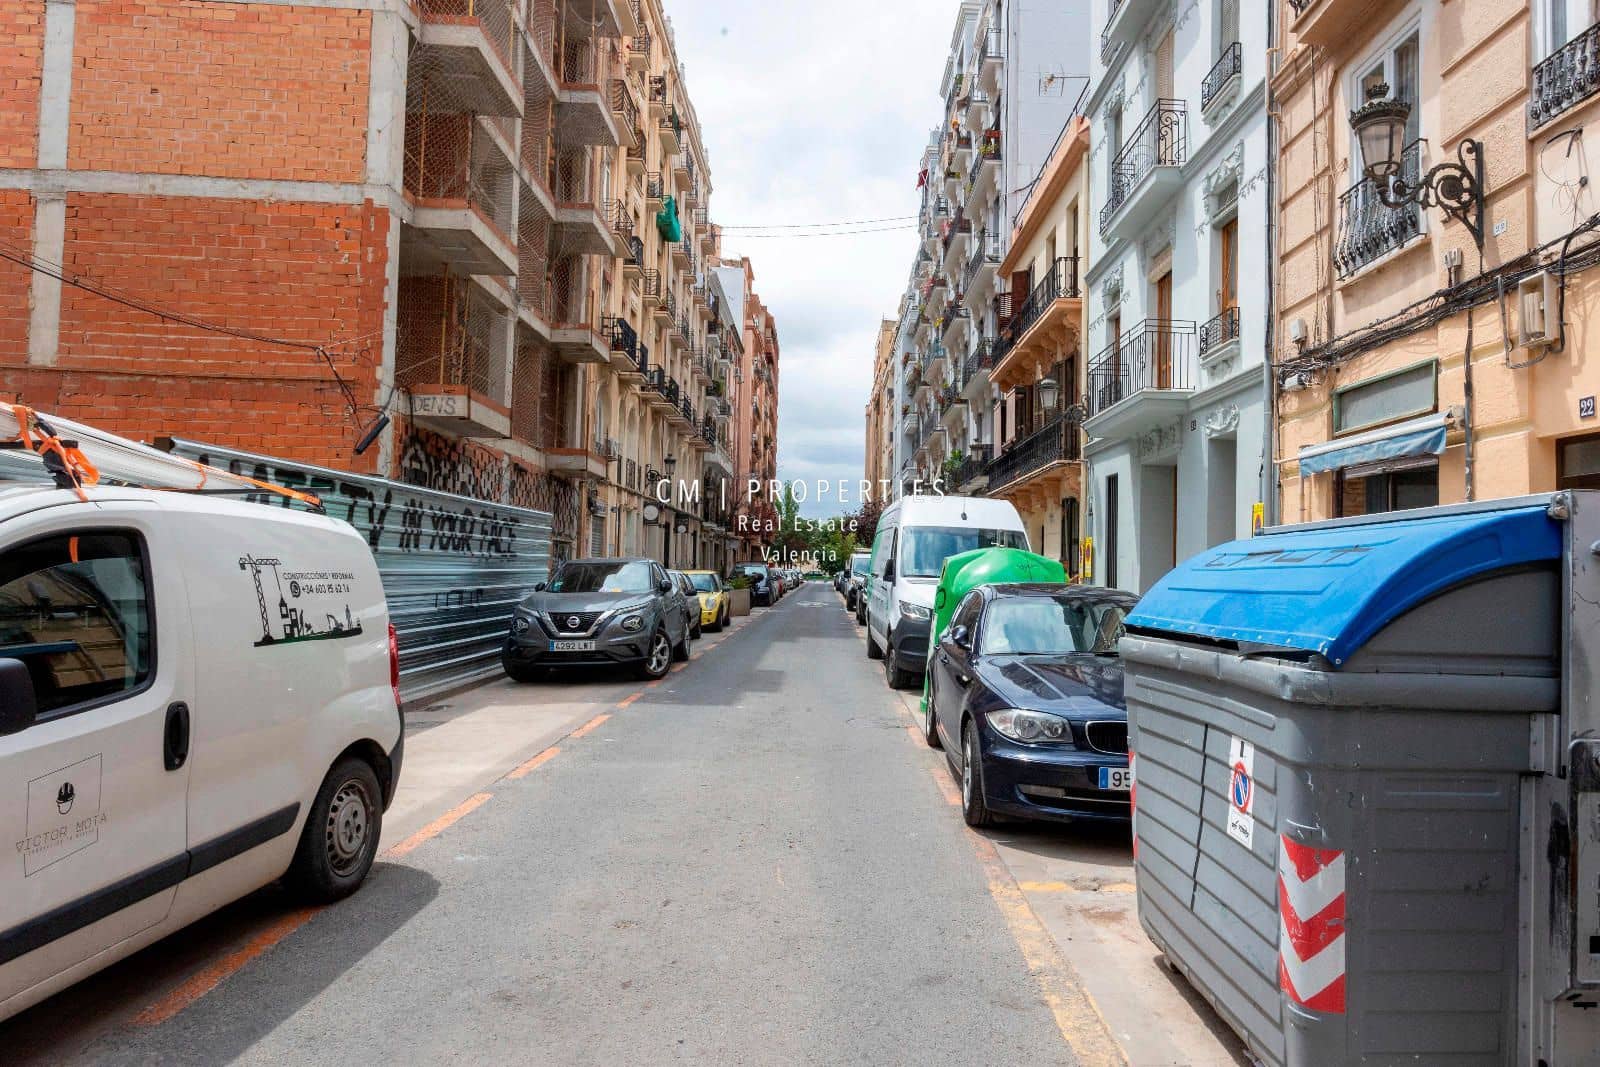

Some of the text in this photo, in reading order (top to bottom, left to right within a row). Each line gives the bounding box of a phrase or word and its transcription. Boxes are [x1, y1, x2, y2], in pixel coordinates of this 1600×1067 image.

[1580, 398, 1593, 416] 22
[428, 504, 475, 556] YOUR
[302, 584, 313, 594] +34
